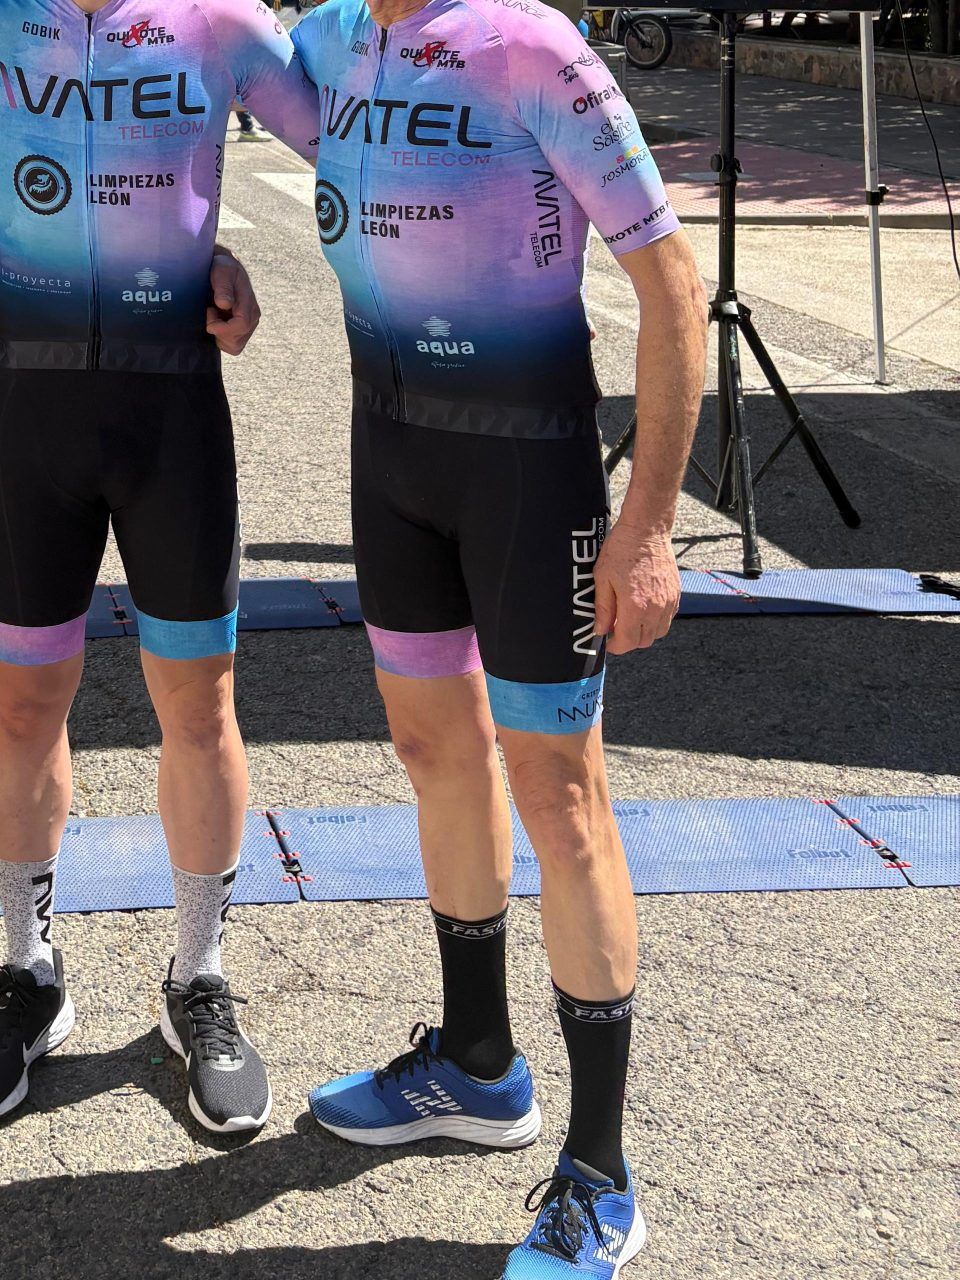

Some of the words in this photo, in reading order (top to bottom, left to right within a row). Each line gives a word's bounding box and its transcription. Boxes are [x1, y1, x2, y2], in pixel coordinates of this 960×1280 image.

[22, 21, 60, 40] GOBIK
[147, 35, 175, 46] MTB
[437, 60, 465, 69] MTB
[321, 84, 493, 149] AVATEL
[118, 121, 204, 141] TELECOM
[391, 150, 491, 167] TELECOM
[90, 173, 175, 189] LIMPIEZAS
[90, 189, 131, 206] LEÓN
[361, 202, 454, 221] LIMPIEZAS
[532, 169, 562, 266] AVATEL
[643, 205, 666, 225] MTB
[361, 220, 400, 239] LEÓN
[529, 231, 543, 268] TELECOM
[122, 290, 172, 304] aqua
[416, 340, 475, 356] aqua
[571, 517, 597, 656] AVATEL
